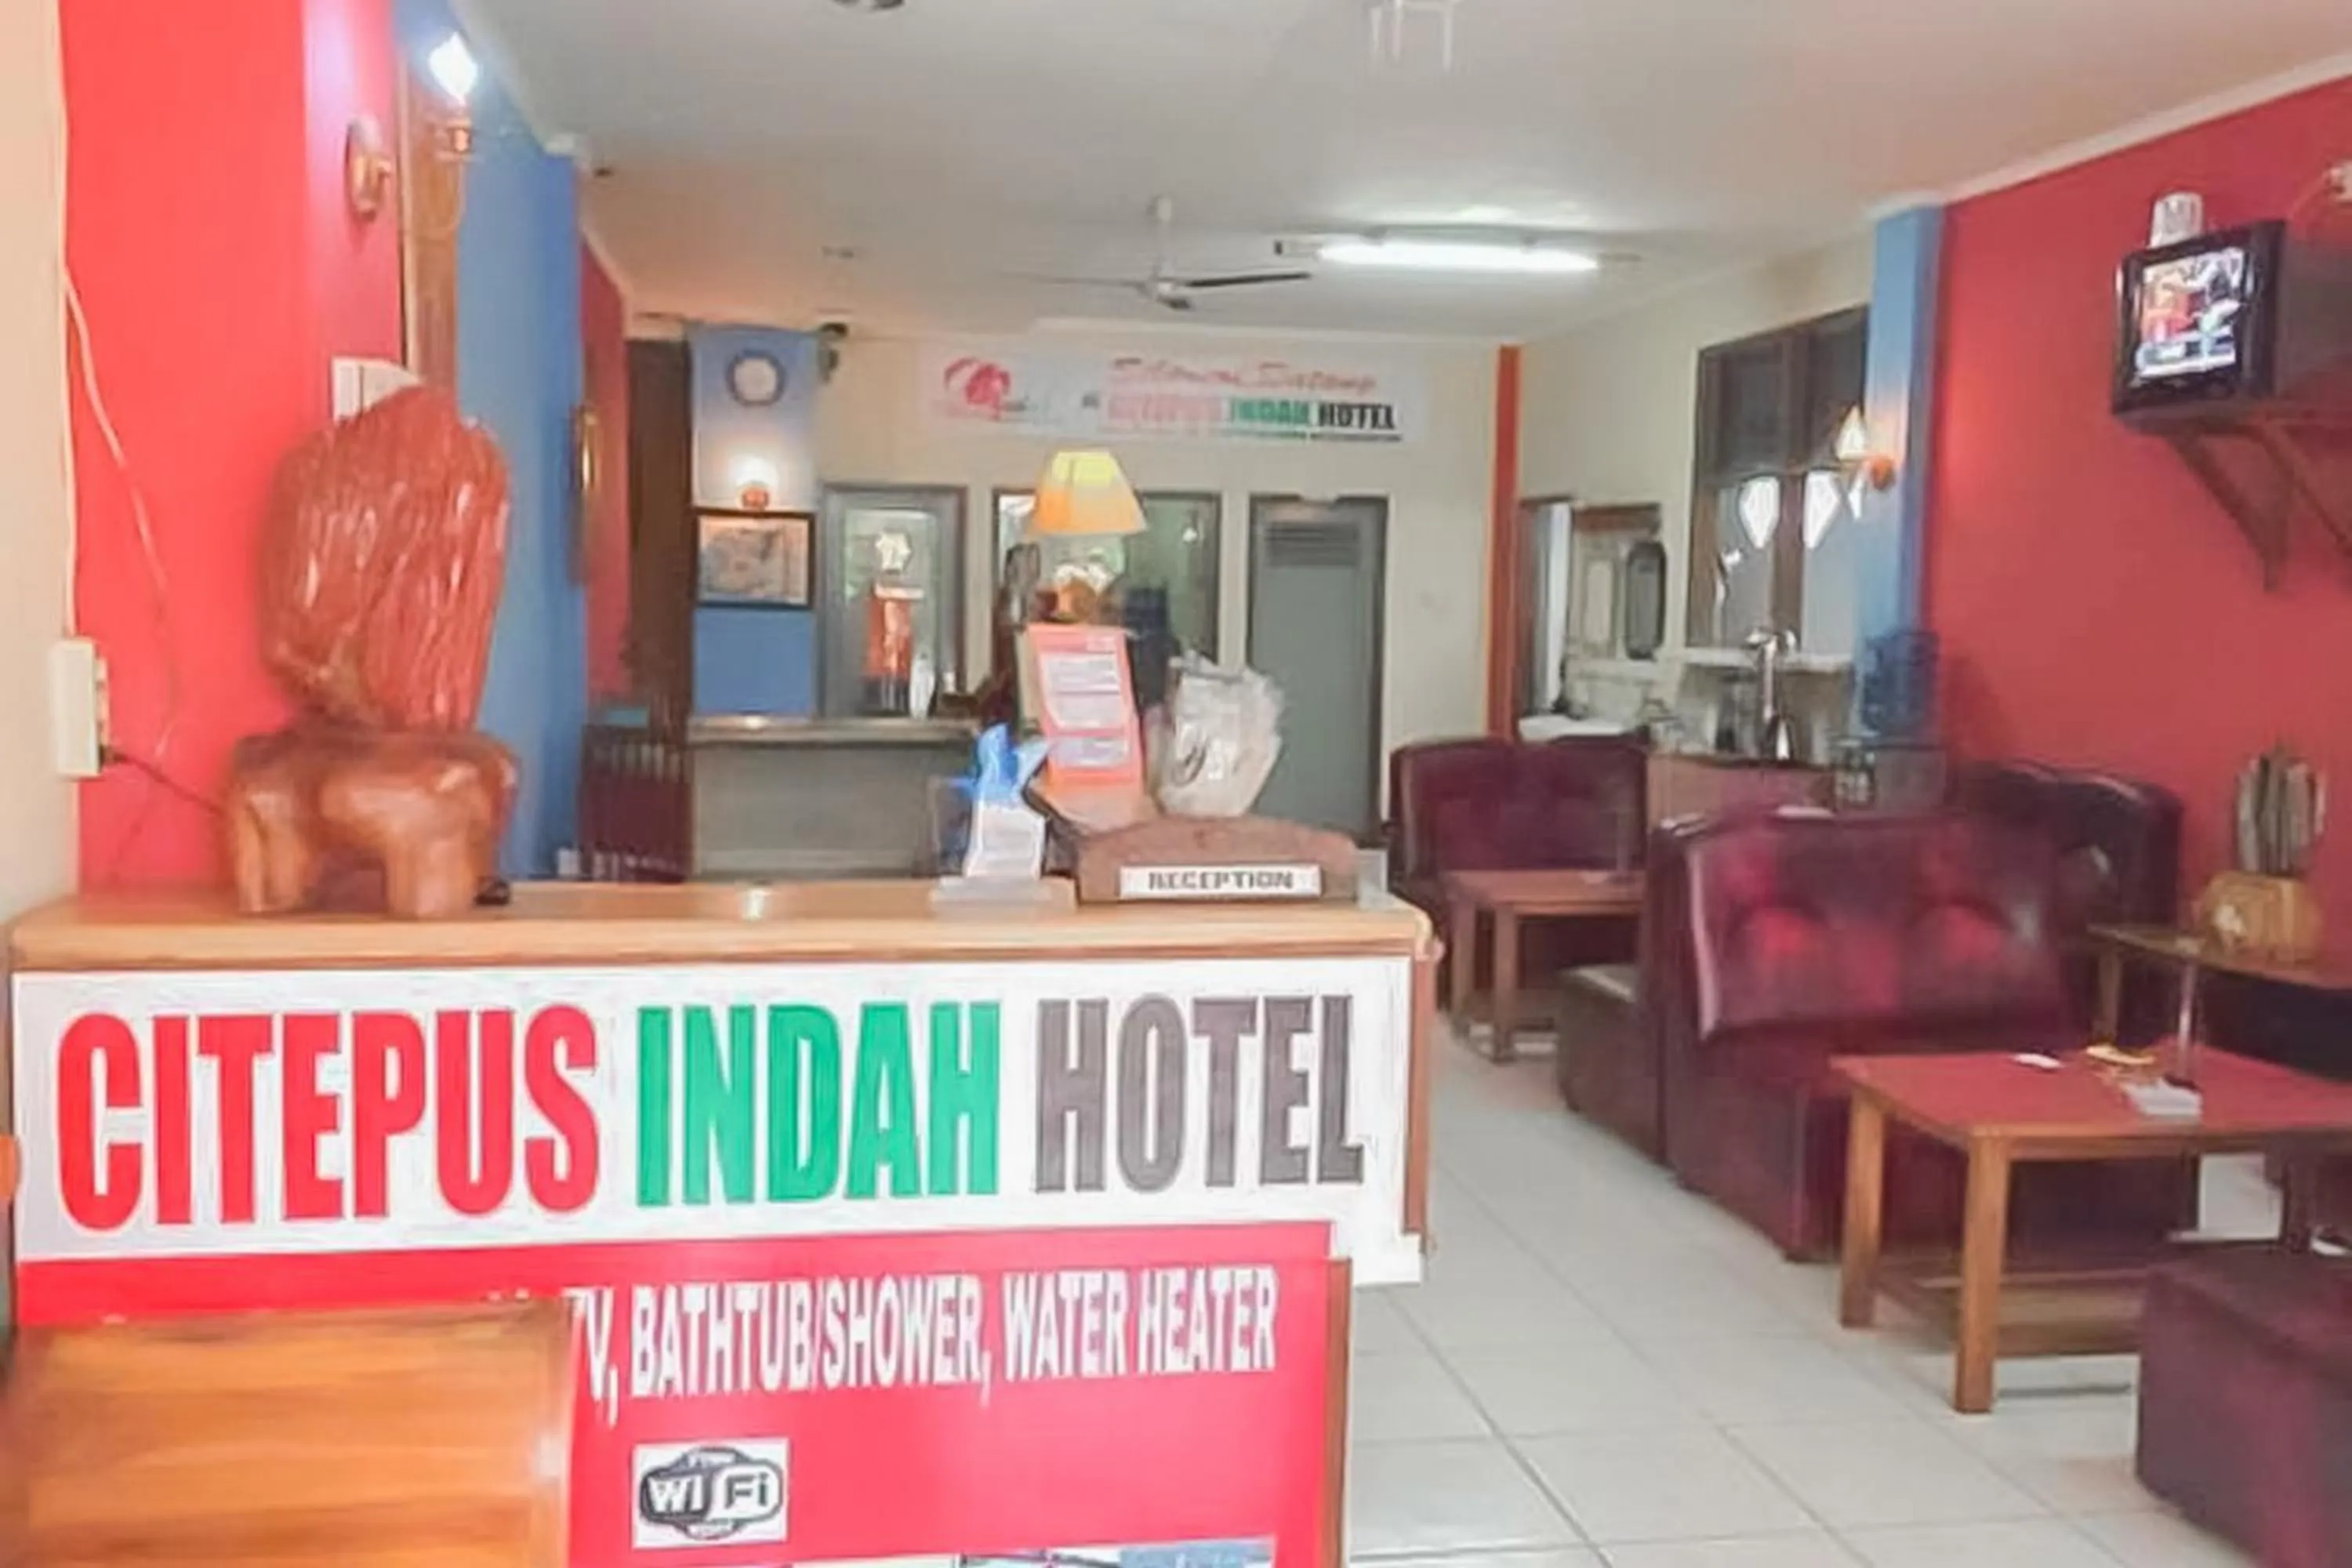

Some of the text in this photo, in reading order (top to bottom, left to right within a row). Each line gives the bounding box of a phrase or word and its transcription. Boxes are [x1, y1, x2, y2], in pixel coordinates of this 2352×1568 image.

[1317, 399, 1396, 430] HOTEL
[1148, 871, 1294, 891] RECEPTION
[57, 993, 1365, 1231] CITEPUS INDAH HOTEL
[1003, 1268, 1128, 1383] WATER
[1137, 1263, 1279, 1376] HEATER
